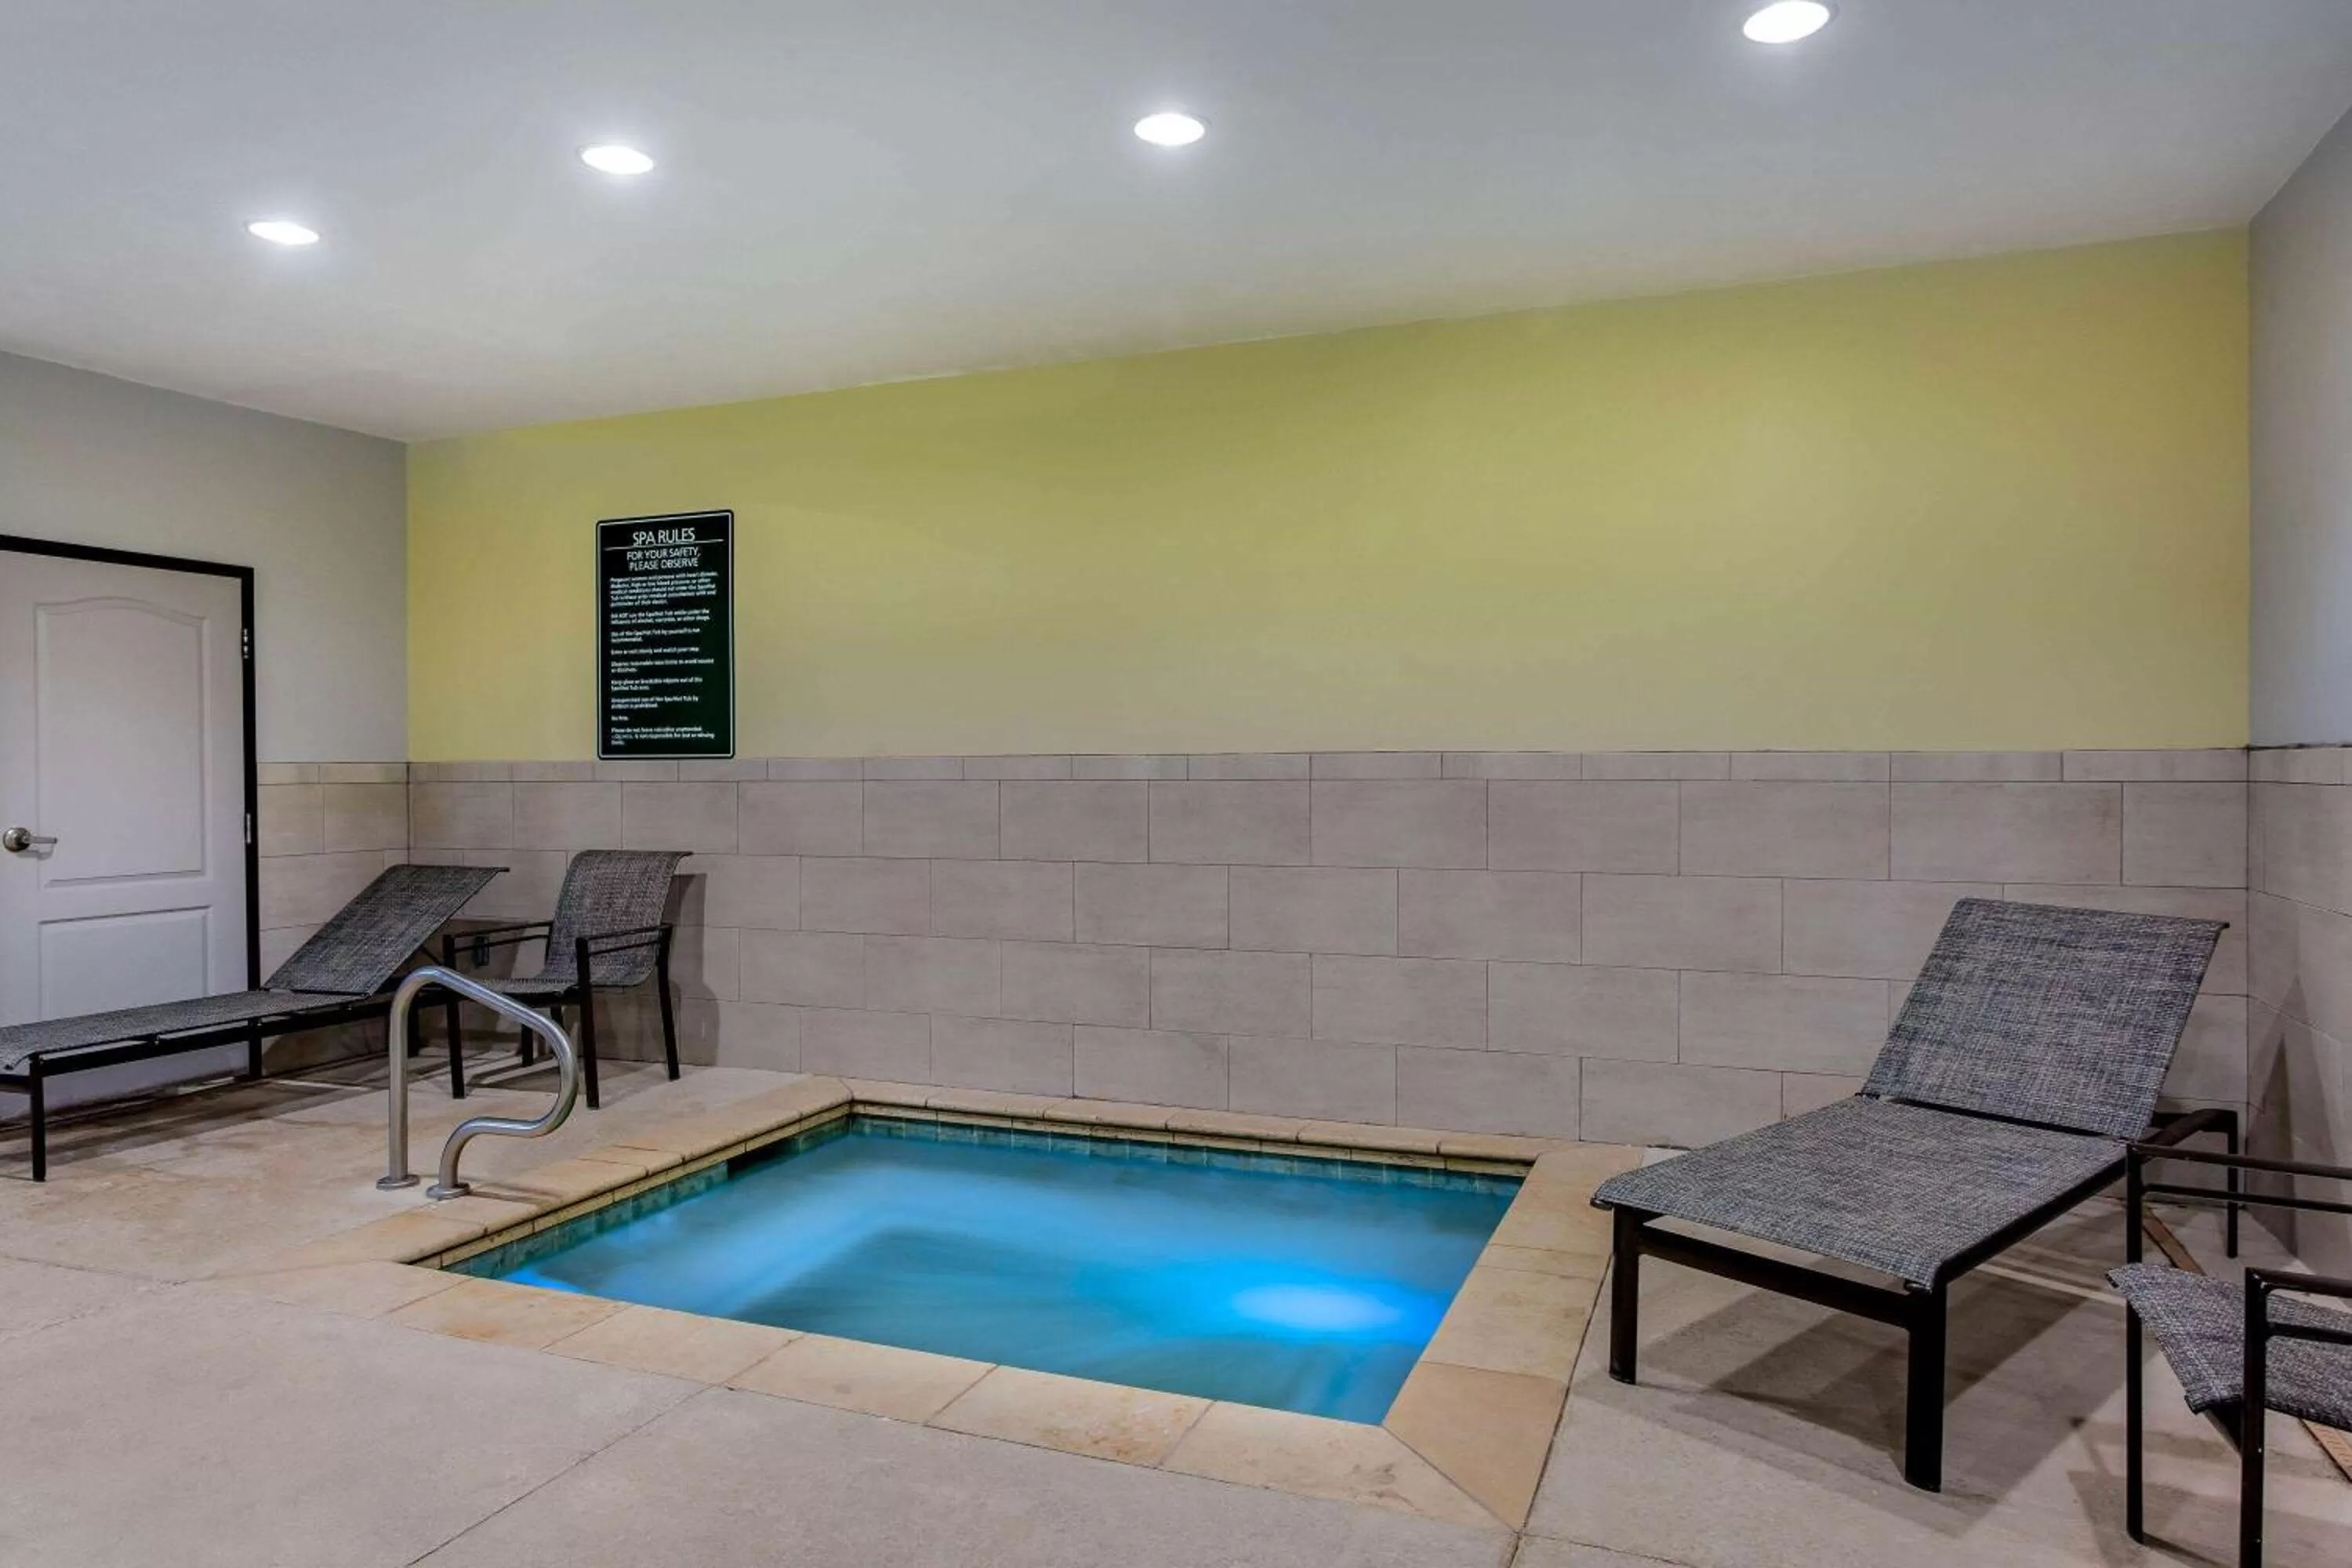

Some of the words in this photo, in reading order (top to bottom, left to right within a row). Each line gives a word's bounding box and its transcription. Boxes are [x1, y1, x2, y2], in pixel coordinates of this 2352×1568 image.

[633, 531, 656, 546] SPA
[658, 528, 695, 543] RULES
[626, 550, 644, 561] FOR
[644, 549, 669, 559] YOUR
[630, 560, 659, 571] PLEASE
[660, 557, 699, 568] OBSERVE
